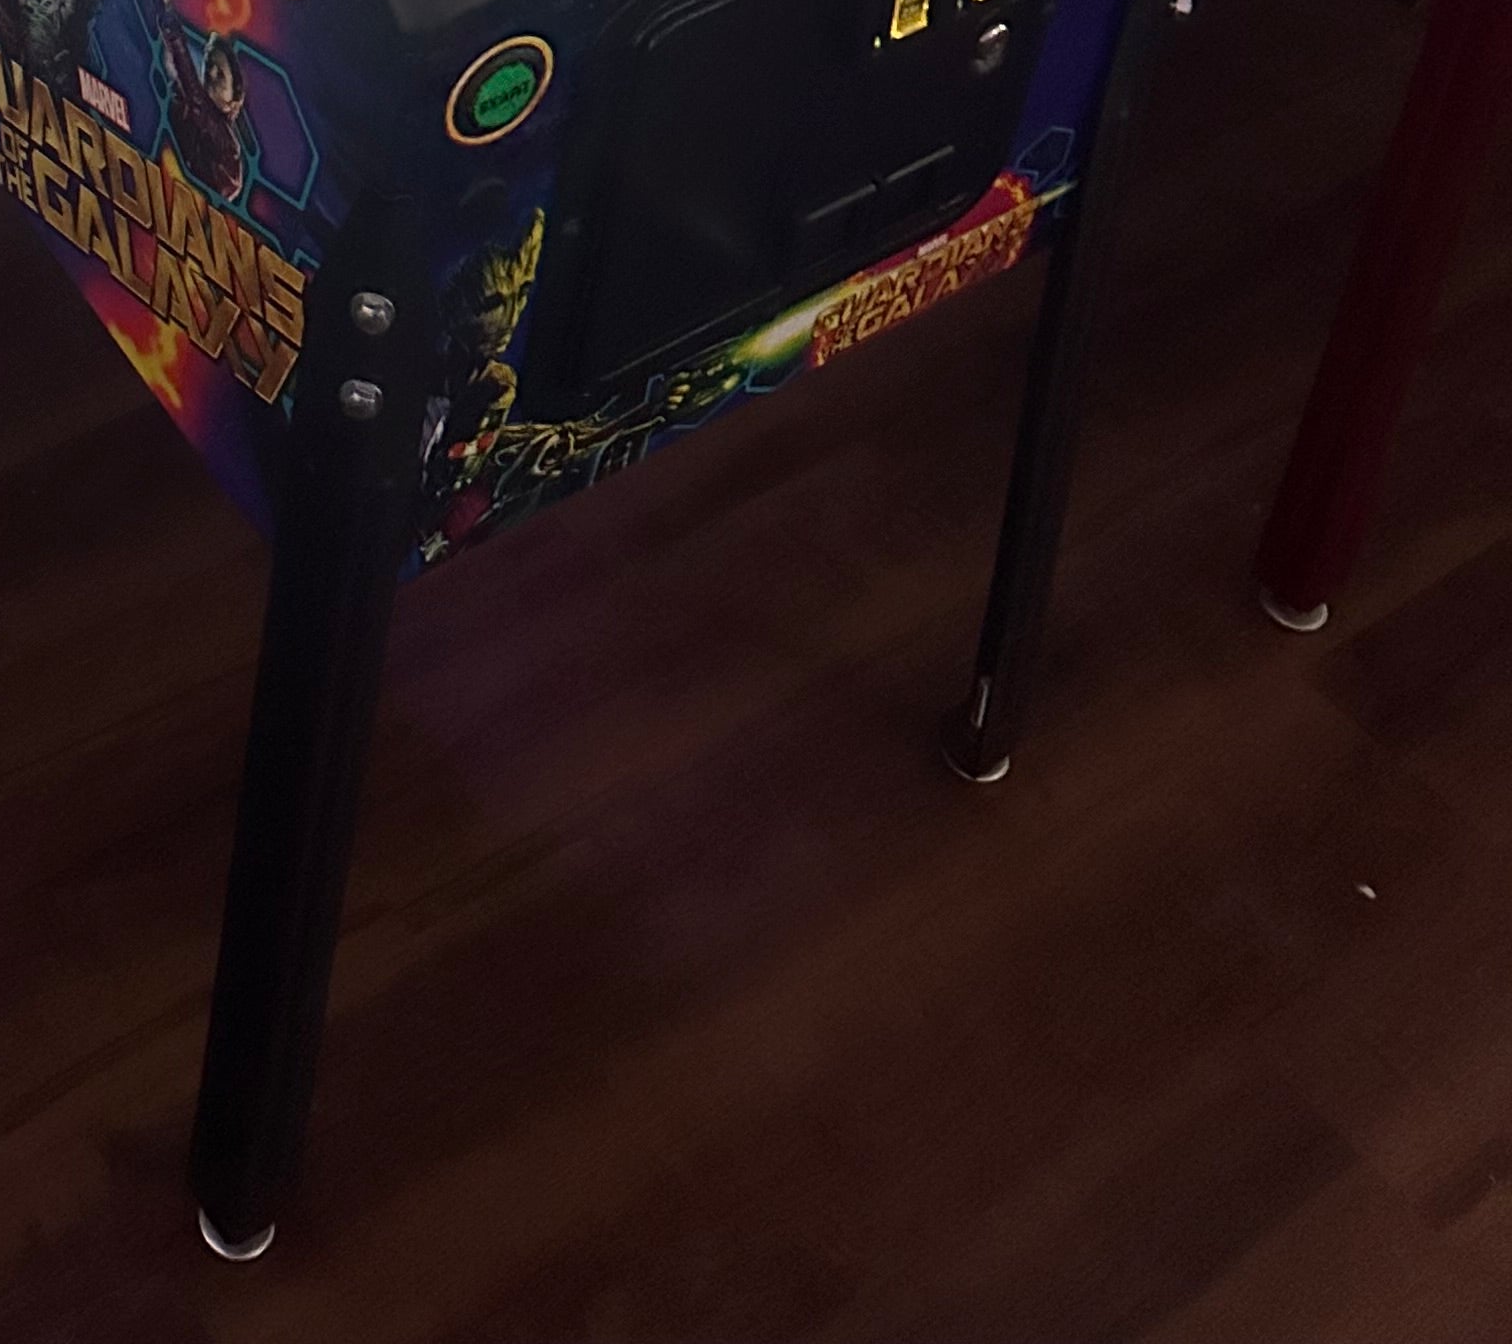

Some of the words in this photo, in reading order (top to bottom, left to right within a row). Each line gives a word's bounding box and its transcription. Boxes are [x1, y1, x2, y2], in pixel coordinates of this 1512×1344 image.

[78, 67, 131, 133] MARVEL
[0, 121, 31, 168] OF
[31, 151, 301, 404] GALAXY
[815, 205, 1035, 338] GUARDIANS
